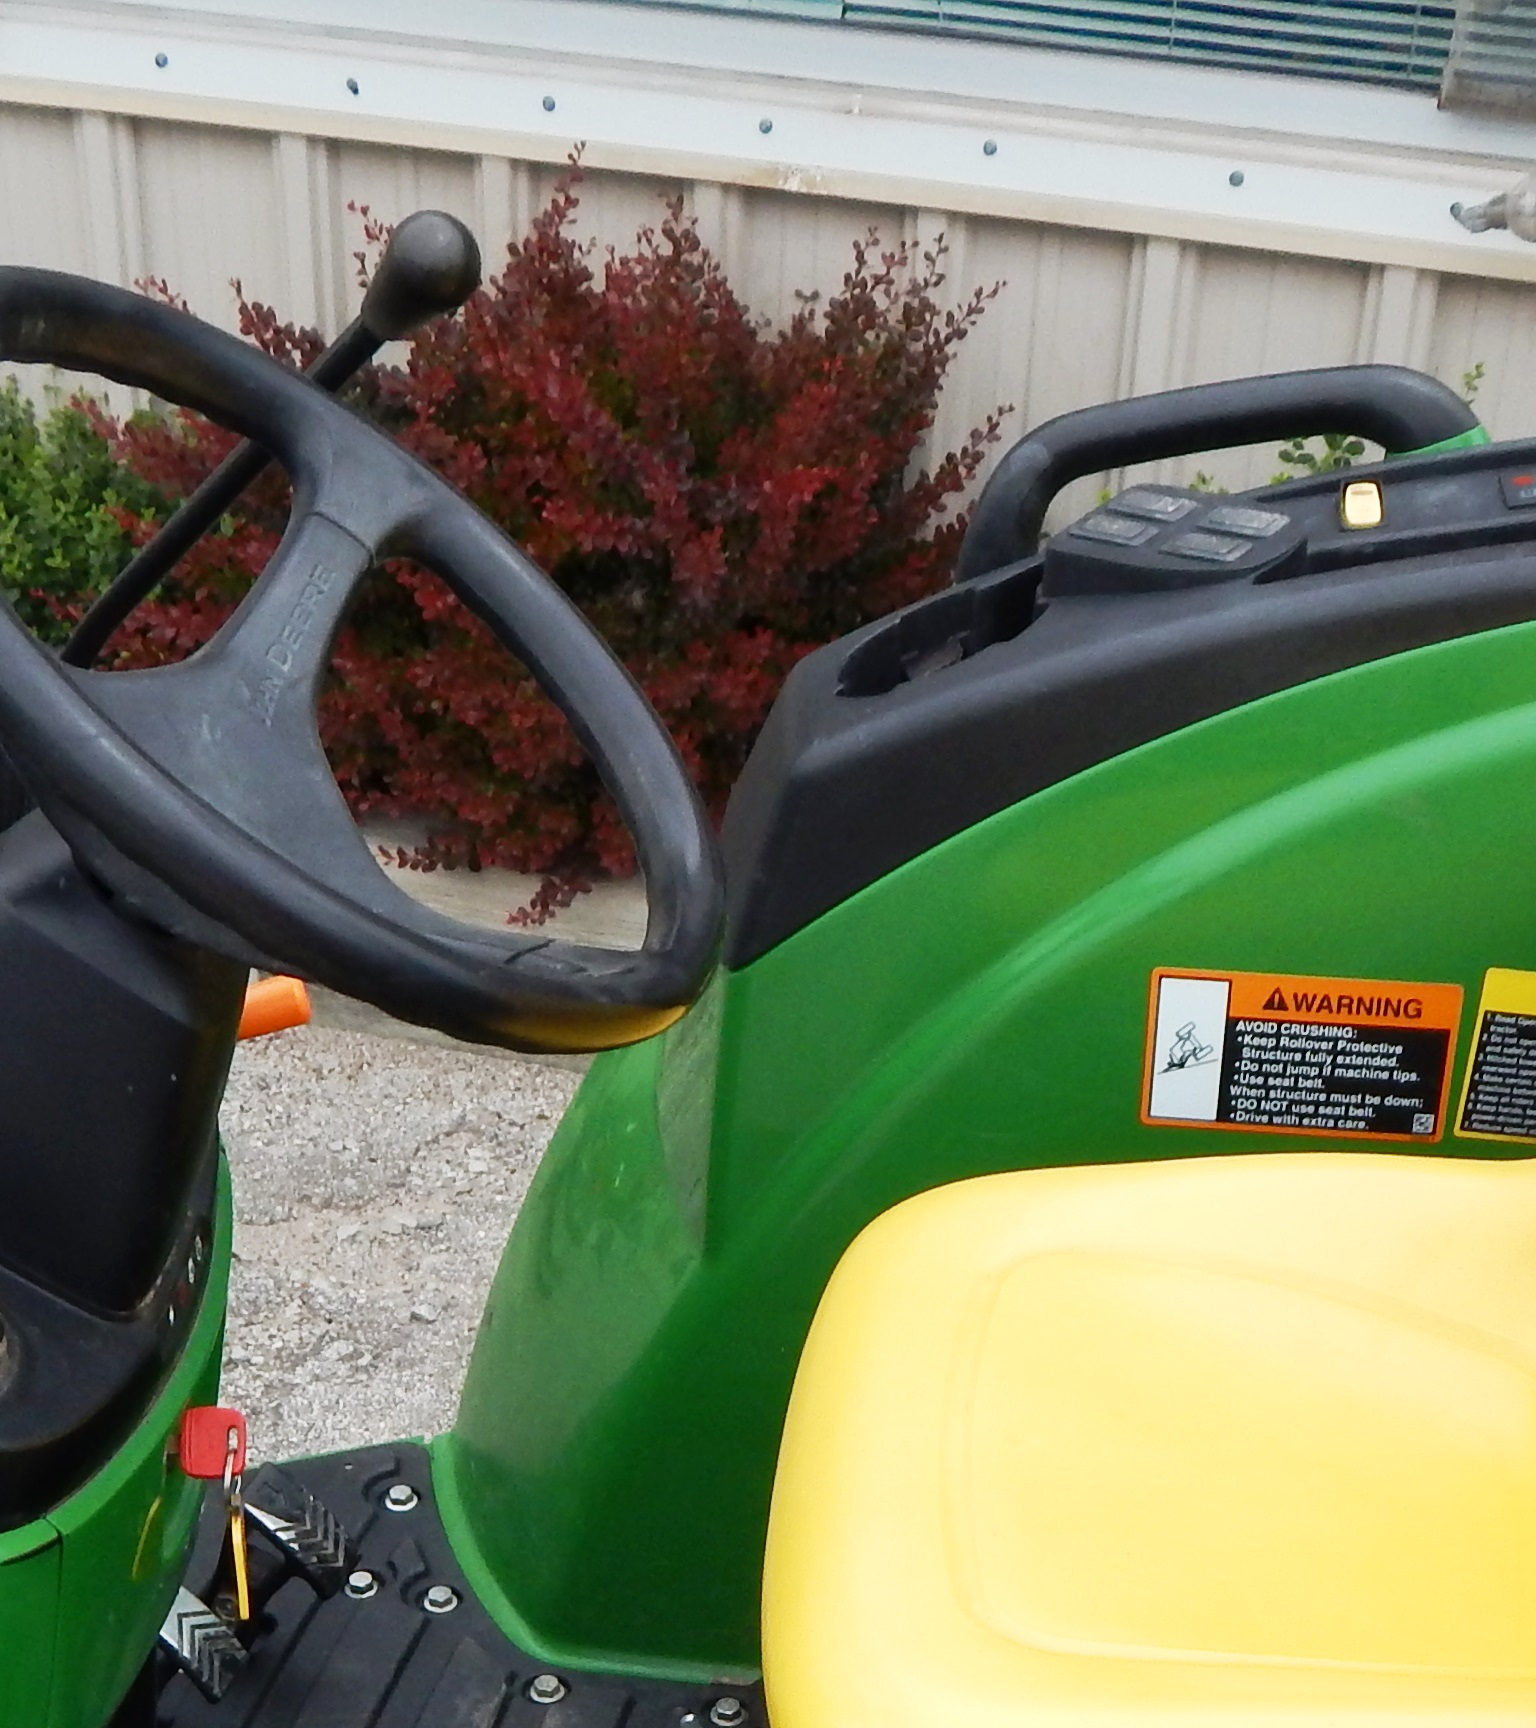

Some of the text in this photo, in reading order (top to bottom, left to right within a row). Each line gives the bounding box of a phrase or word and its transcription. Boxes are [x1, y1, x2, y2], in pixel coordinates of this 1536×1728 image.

[265, 565, 336, 672] DEERE
[1293, 992, 1423, 1018] WARNING
[1236, 1021, 1277, 1034] AVOID
[1280, 1037, 1333, 1049] Rollover
[1337, 1040, 1403, 1054] Protective
[1242, 1047, 1399, 1067] Structure fully extended.
[1239, 1073, 1325, 1089] Use seat belt.
[1241, 1060, 1420, 1083] Do not jump if machine tips.
[1230, 1085, 1265, 1097] When
[1269, 1087, 1326, 1101] structure
[1330, 1093, 1362, 1103] must
[1365, 1094, 1380, 1104] be
[1237, 1098, 1376, 1118] DO NOT use seat belt.
[1236, 1111, 1369, 1130] Drive with extra care.
